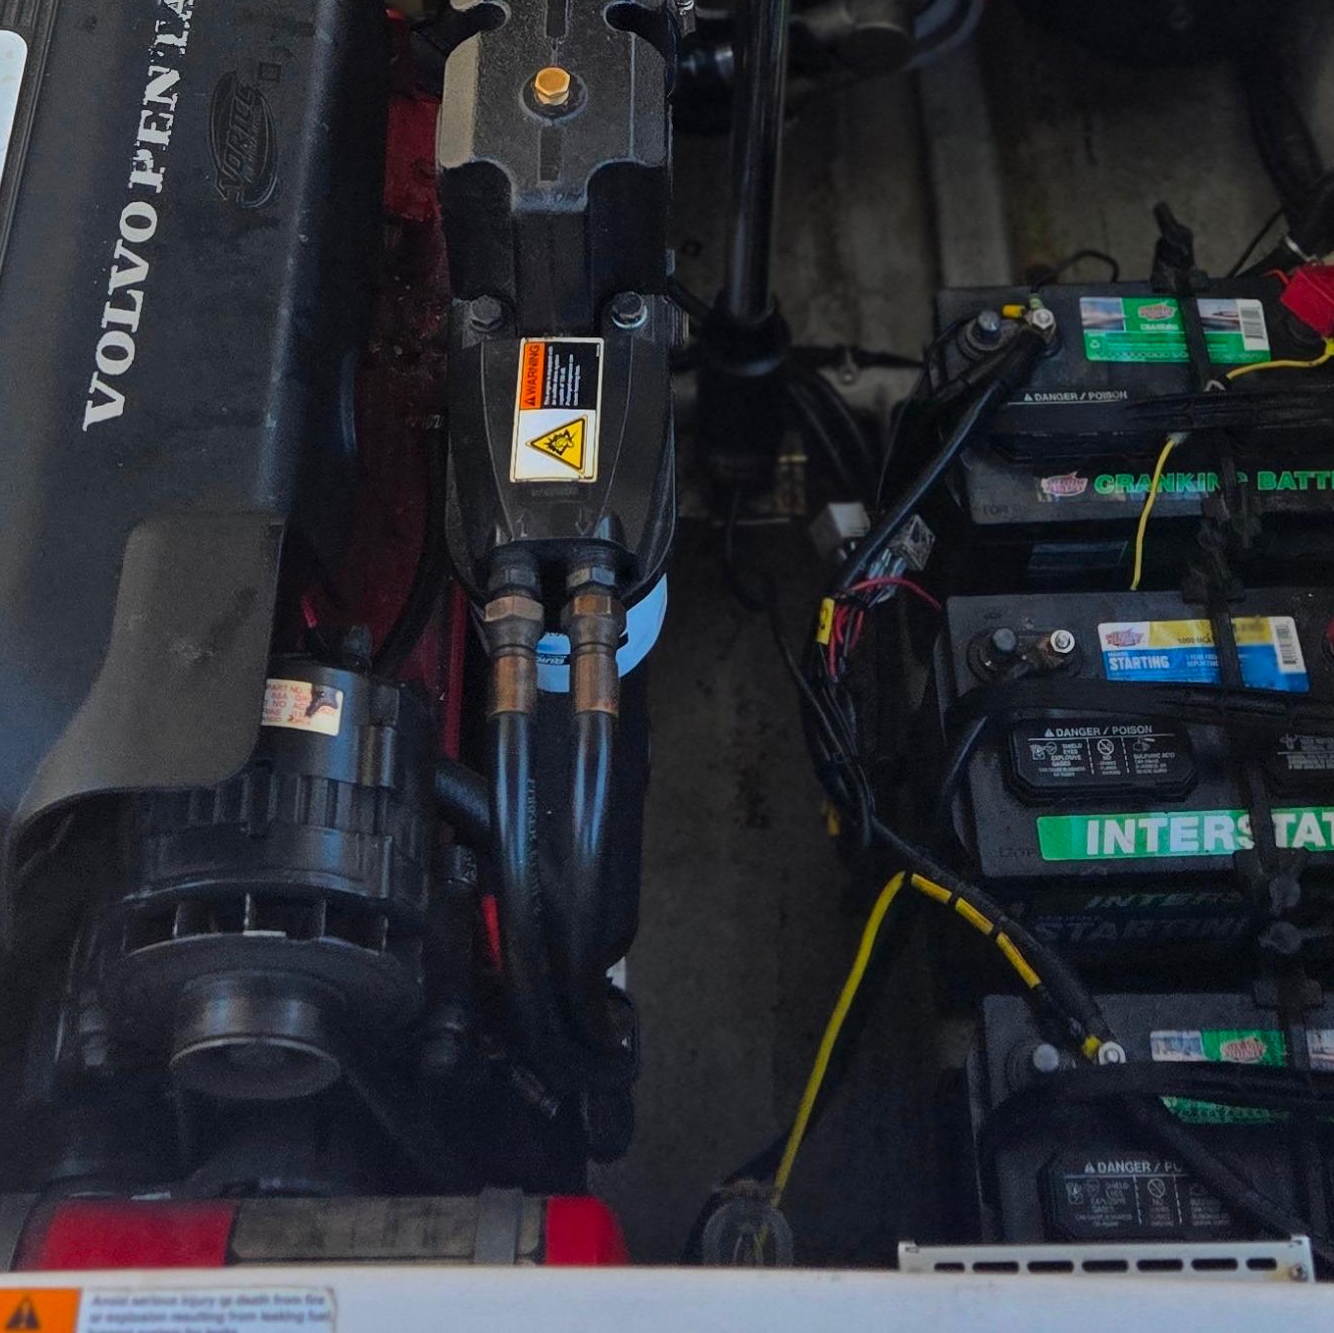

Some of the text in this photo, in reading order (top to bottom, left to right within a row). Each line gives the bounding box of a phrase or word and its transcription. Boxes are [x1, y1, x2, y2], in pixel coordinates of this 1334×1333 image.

[83, 201, 160, 432] VOLVO
[526, 344, 540, 393] WARNING
[1034, 392, 1078, 402] DANGER
[1088, 390, 1128, 401] POISON
[1108, 655, 1170, 671] STARTING
[1056, 728, 1101, 737] DANGER
[1112, 725, 1153, 735] POISON
[1097, 1161, 1152, 1173] DANGER
